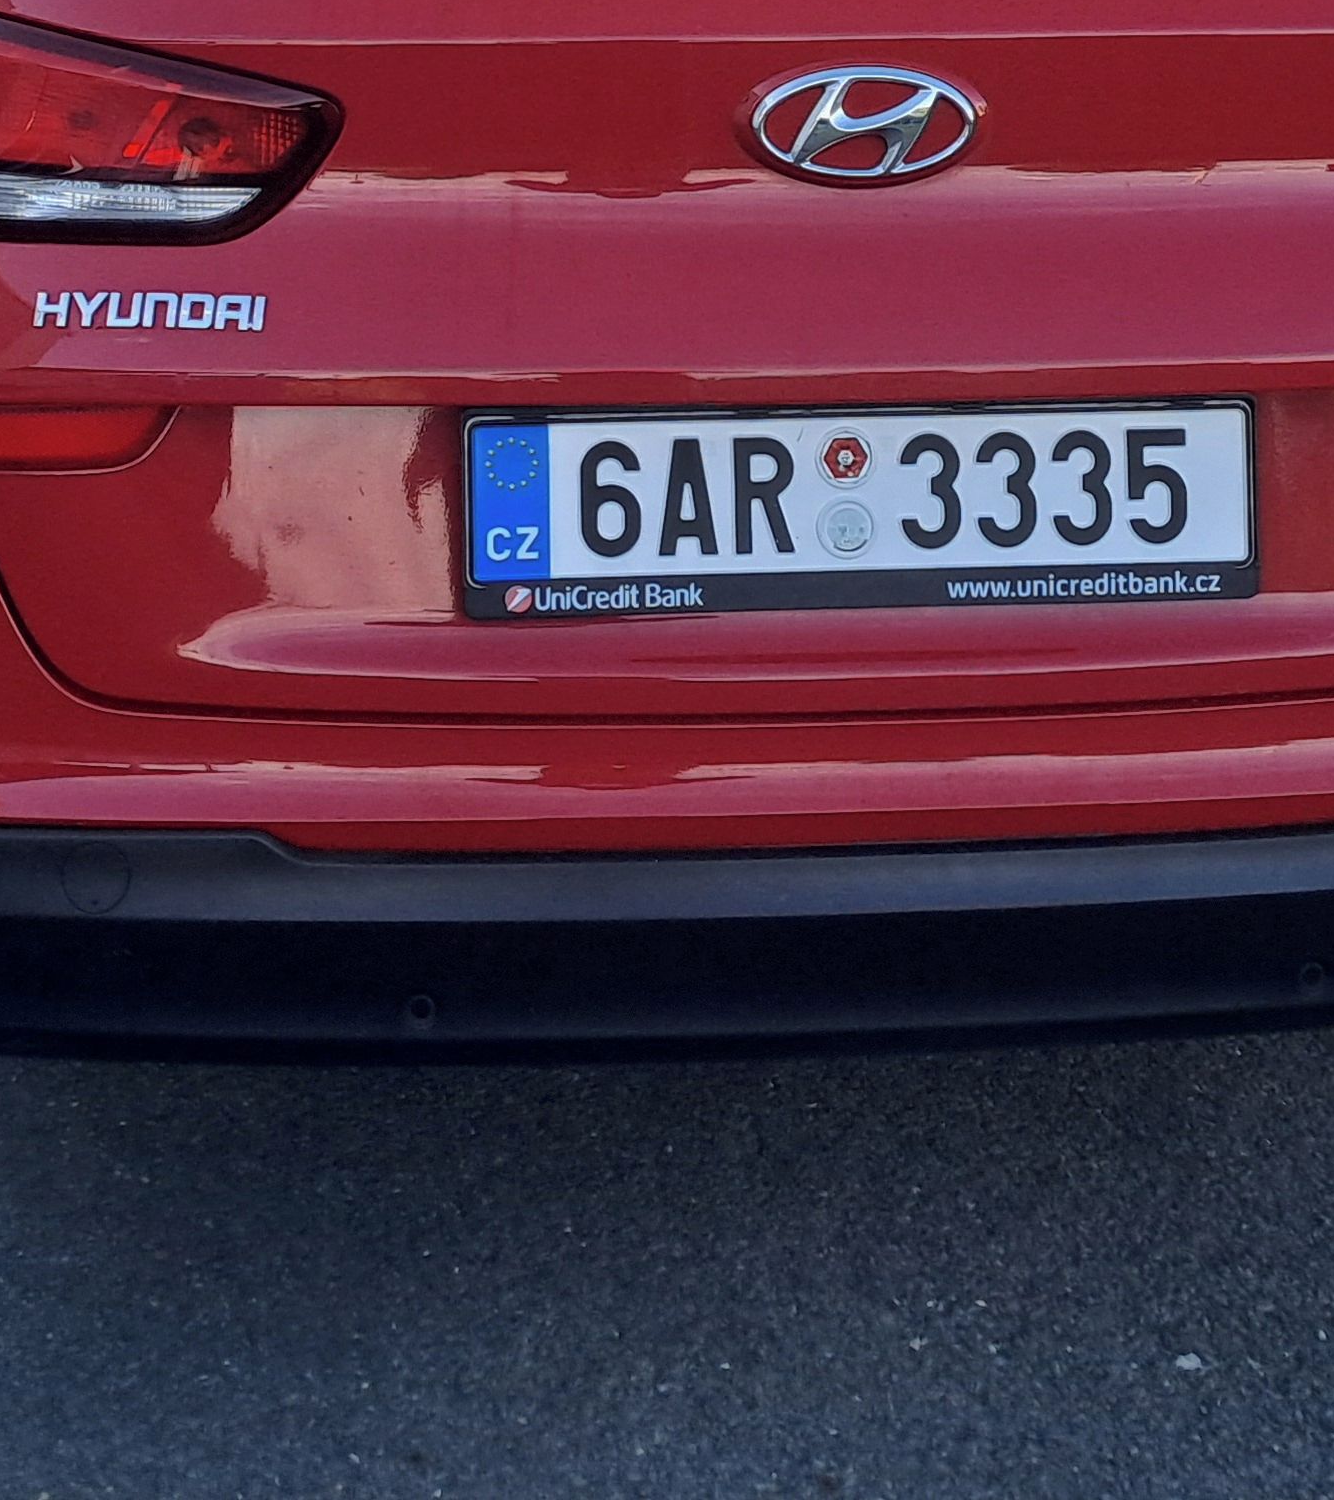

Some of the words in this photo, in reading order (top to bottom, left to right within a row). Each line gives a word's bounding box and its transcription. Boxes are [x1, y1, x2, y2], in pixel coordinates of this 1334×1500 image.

[32, 291, 267, 331] HYUNDAI
[578, 436, 796, 558] 6AR
[899, 426, 1188, 551] 3335
[485, 526, 540, 562] CZ
[534, 583, 639, 611] UniCredit
[645, 582, 704, 609] Bank
[947, 570, 1221, 599] www.unicreditbank.cz
